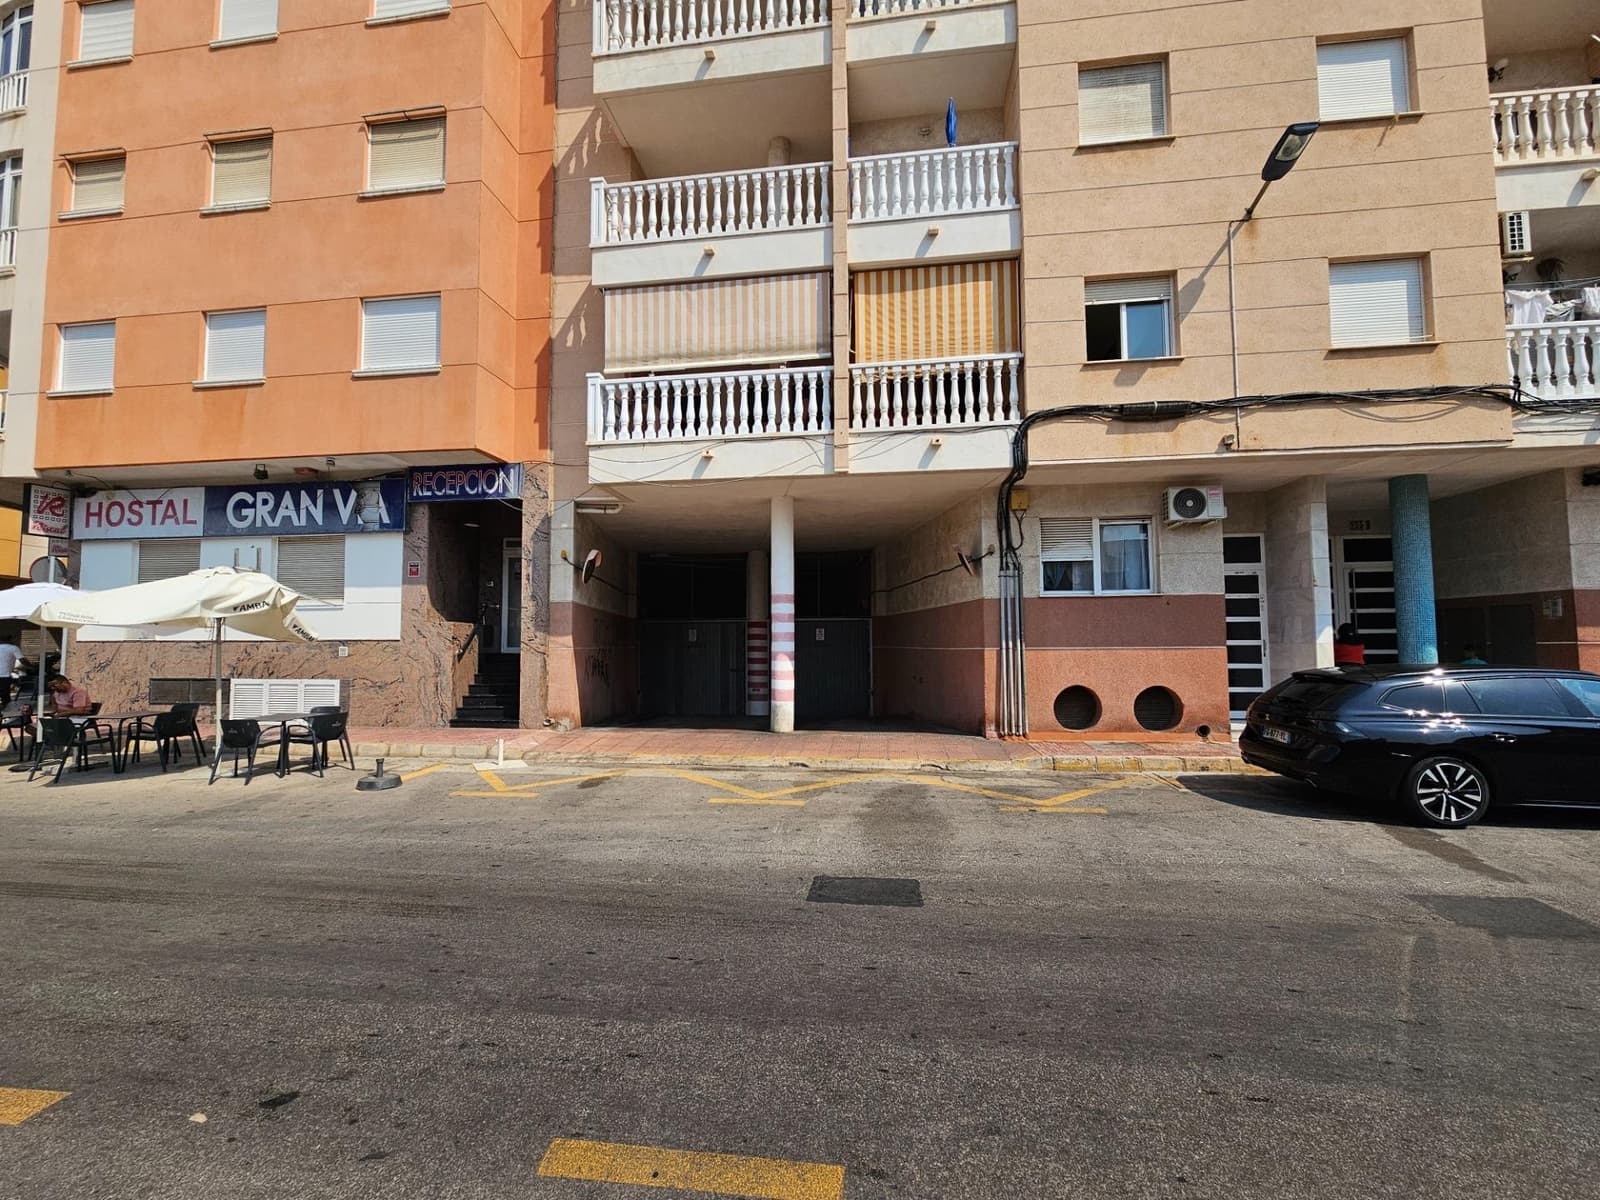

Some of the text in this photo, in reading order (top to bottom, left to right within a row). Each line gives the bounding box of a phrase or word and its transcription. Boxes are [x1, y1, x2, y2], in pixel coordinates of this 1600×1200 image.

[413, 467, 515, 497] RECEPCION
[85, 498, 198, 528] HOSTAL
[226, 488, 391, 529] GRAN VA
